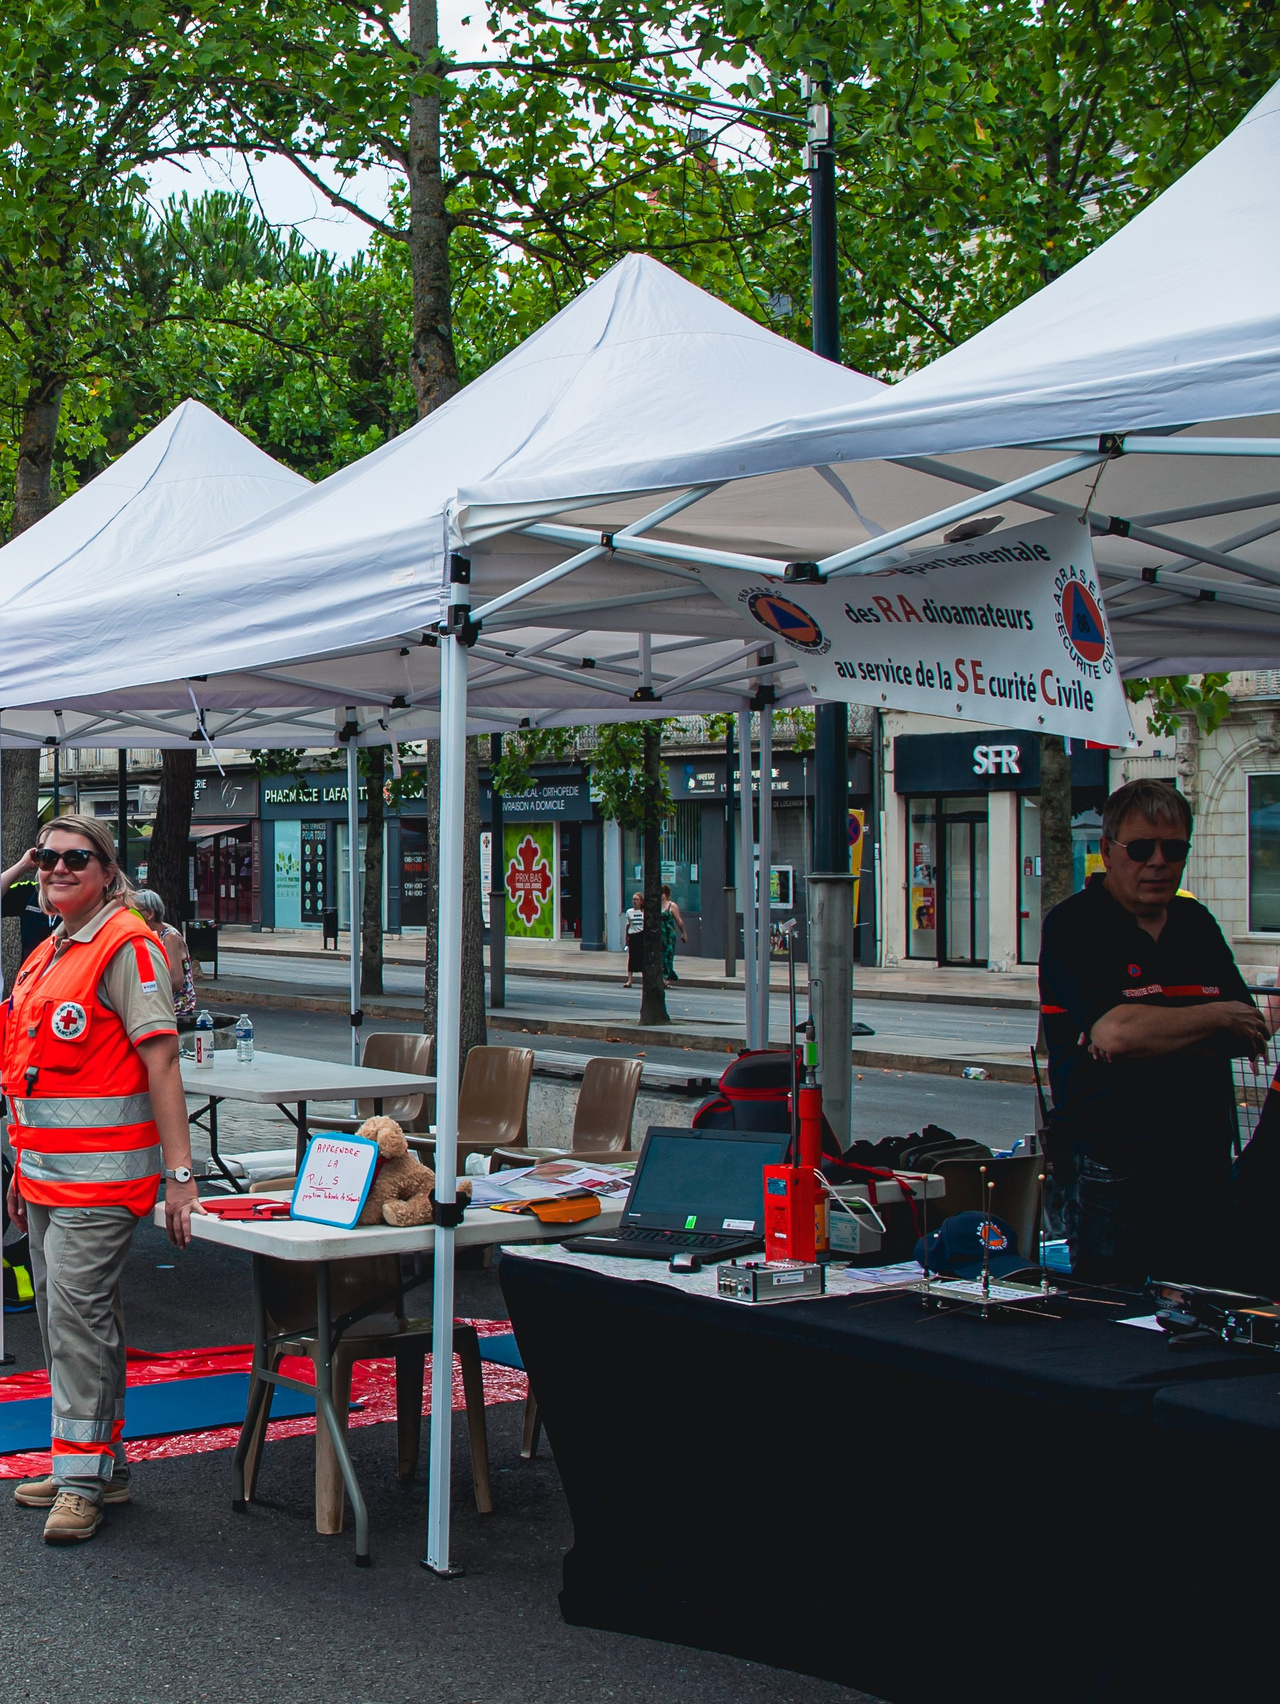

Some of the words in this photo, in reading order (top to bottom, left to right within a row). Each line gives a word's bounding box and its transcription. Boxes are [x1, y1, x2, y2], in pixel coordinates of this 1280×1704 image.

[1075, 612, 1091, 633] 86
[1054, 611, 1102, 680] SECURITE
[834, 660, 857, 680] au
[857, 657, 913, 686] service
[915, 659, 935, 689] de
[936, 661, 953, 691] la
[1040, 668, 1094, 712] Civile
[973, 744, 1021, 775] SFR
[542, 785, 579, 798] ORTHOPEDIE
[771, 781, 790, 791] IENNE
[322, 786, 370, 802] LAFATT
[502, 801, 529, 812] IVRAISON
[535, 799, 565, 811] DOMICILE
[301, 831, 314, 840] POUR
[314, 830, 327, 840] TOUS
[515, 873, 530, 883] PRIX
[530, 872, 542, 882] BAS
[316, 1143, 361, 1157] APPRENDRE
[327, 1159, 339, 1169] LA
